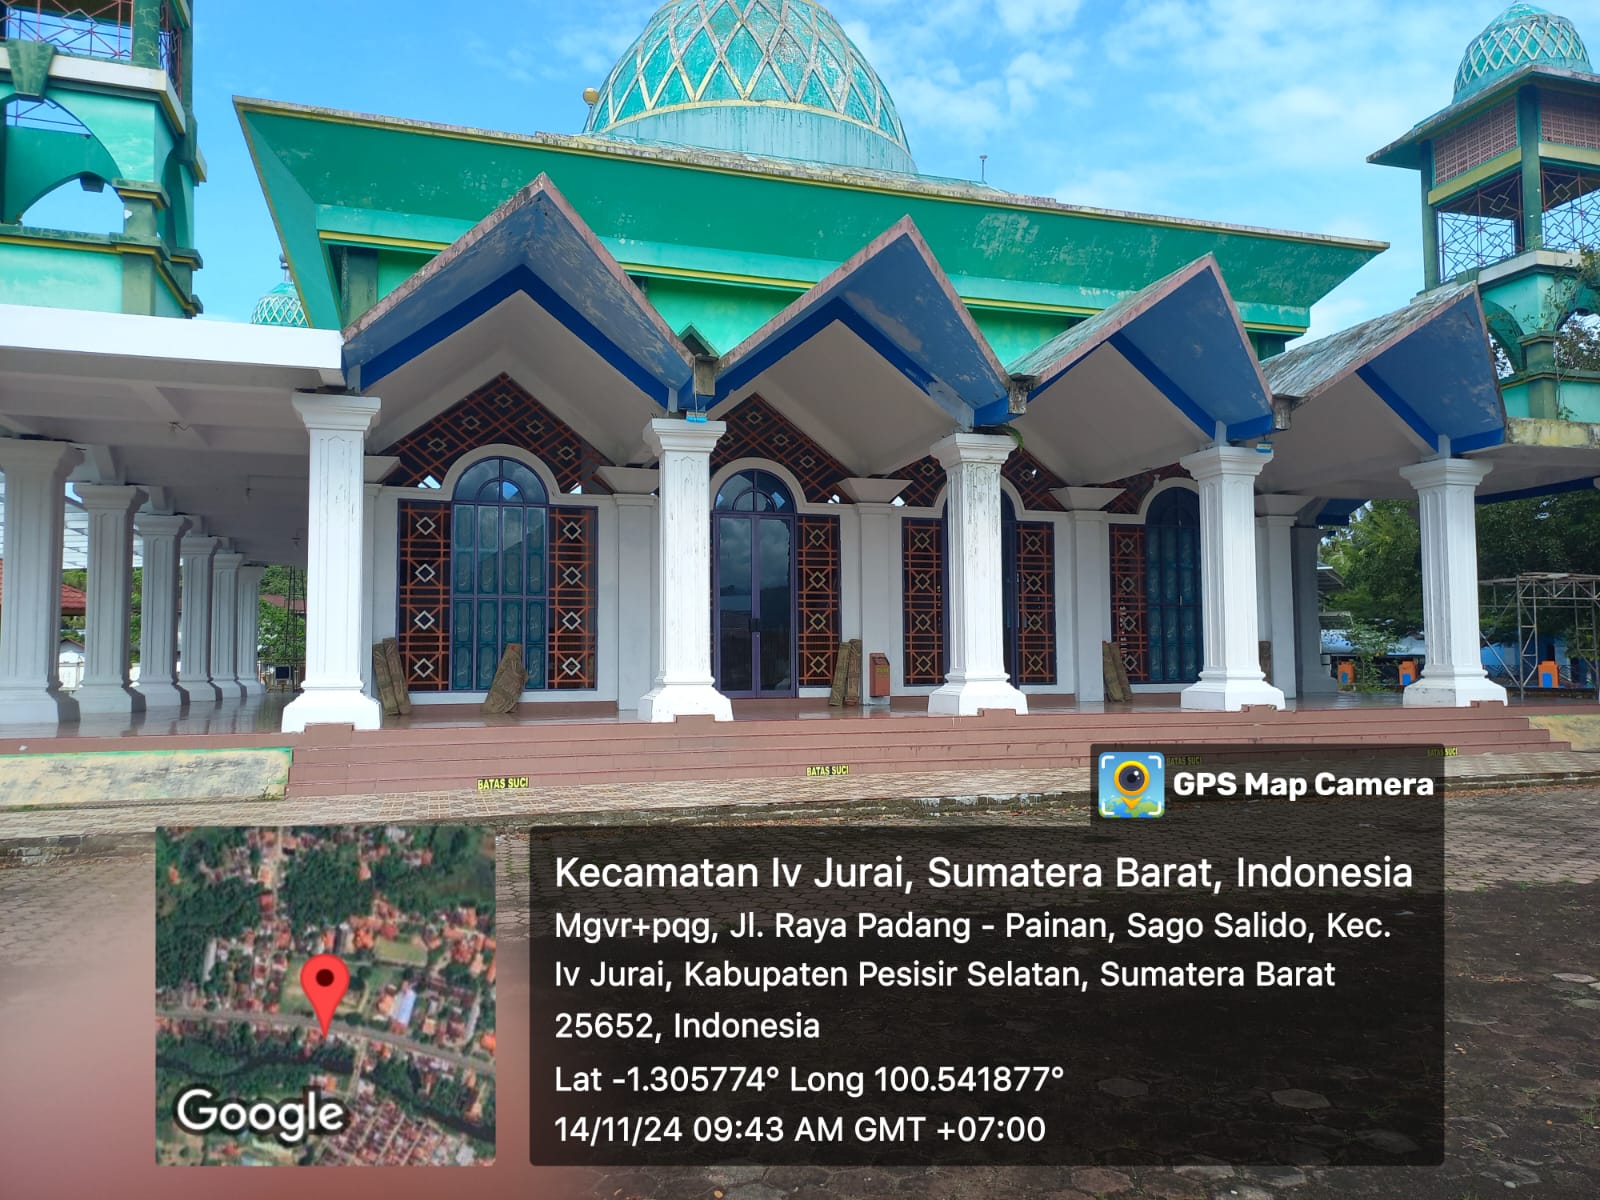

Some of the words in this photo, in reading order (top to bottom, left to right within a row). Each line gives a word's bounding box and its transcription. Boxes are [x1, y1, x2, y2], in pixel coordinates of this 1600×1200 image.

[806, 766, 830, 776] BATAS
[831, 765, 849, 775] SUCI
[477, 779, 506, 790] BATAS
[507, 776, 529, 788] SUCI
